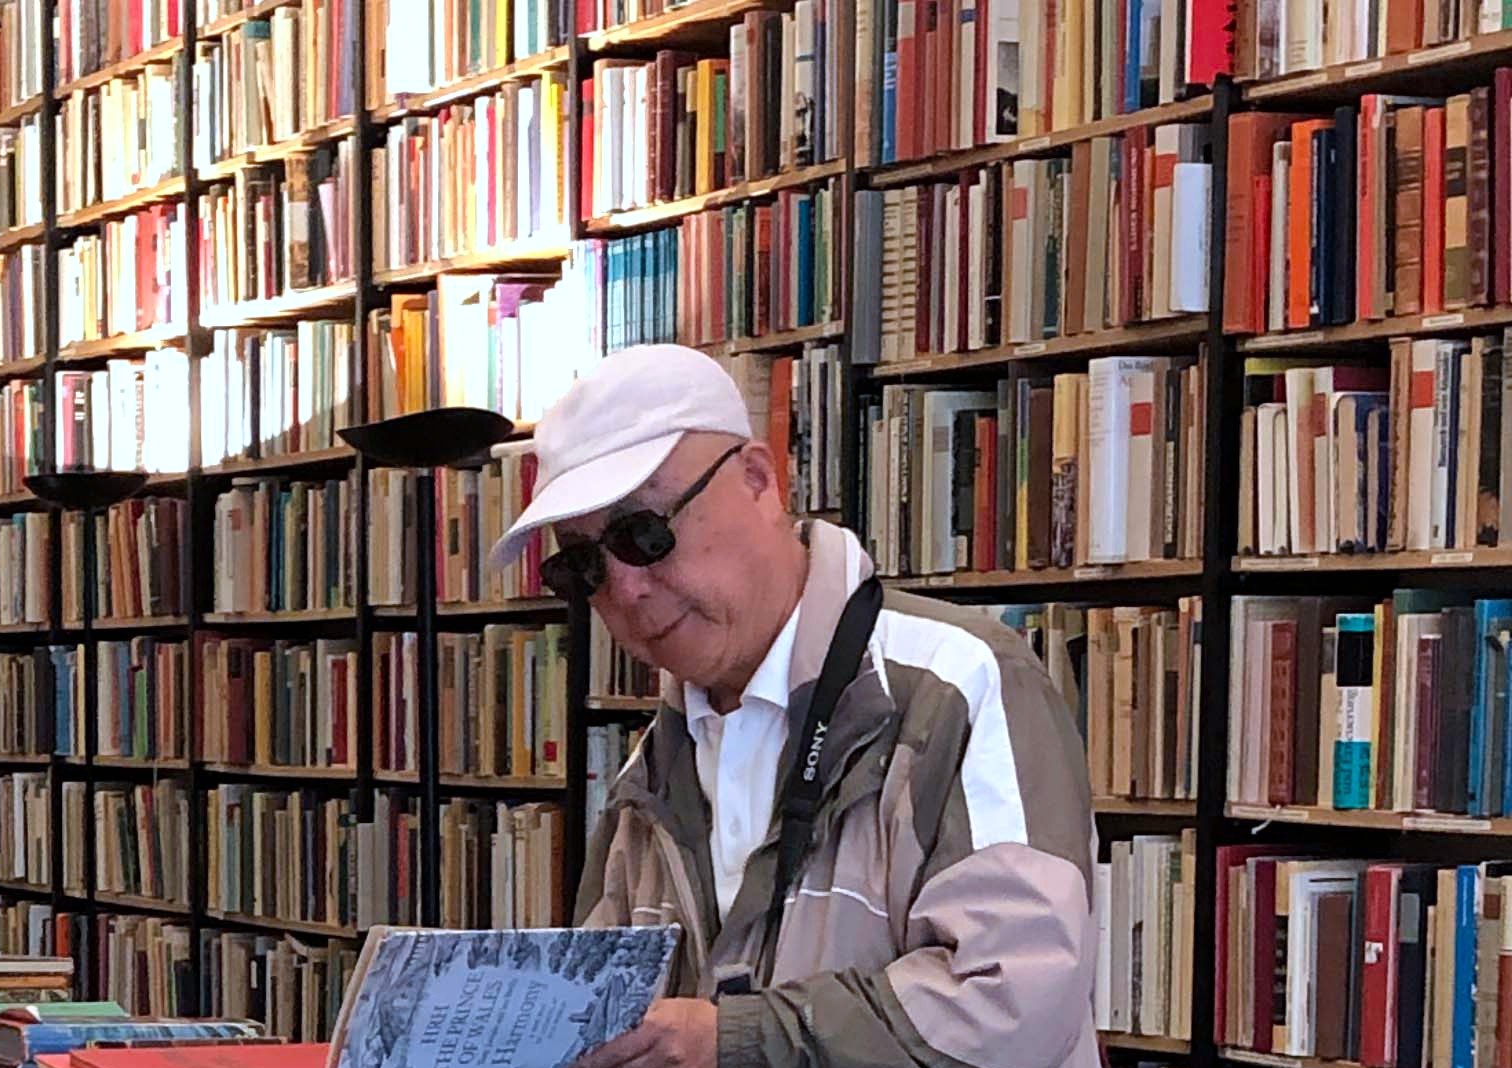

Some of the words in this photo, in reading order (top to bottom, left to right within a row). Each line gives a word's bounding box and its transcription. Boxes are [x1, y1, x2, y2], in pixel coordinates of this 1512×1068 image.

[803, 720, 828, 781] SONY
[421, 1005, 450, 1049] HRH
[445, 972, 483, 1037] PRINCE
[465, 980, 503, 1039] WALES
[491, 979, 548, 1066] Harmony
[458, 1037, 477, 1065] OF
